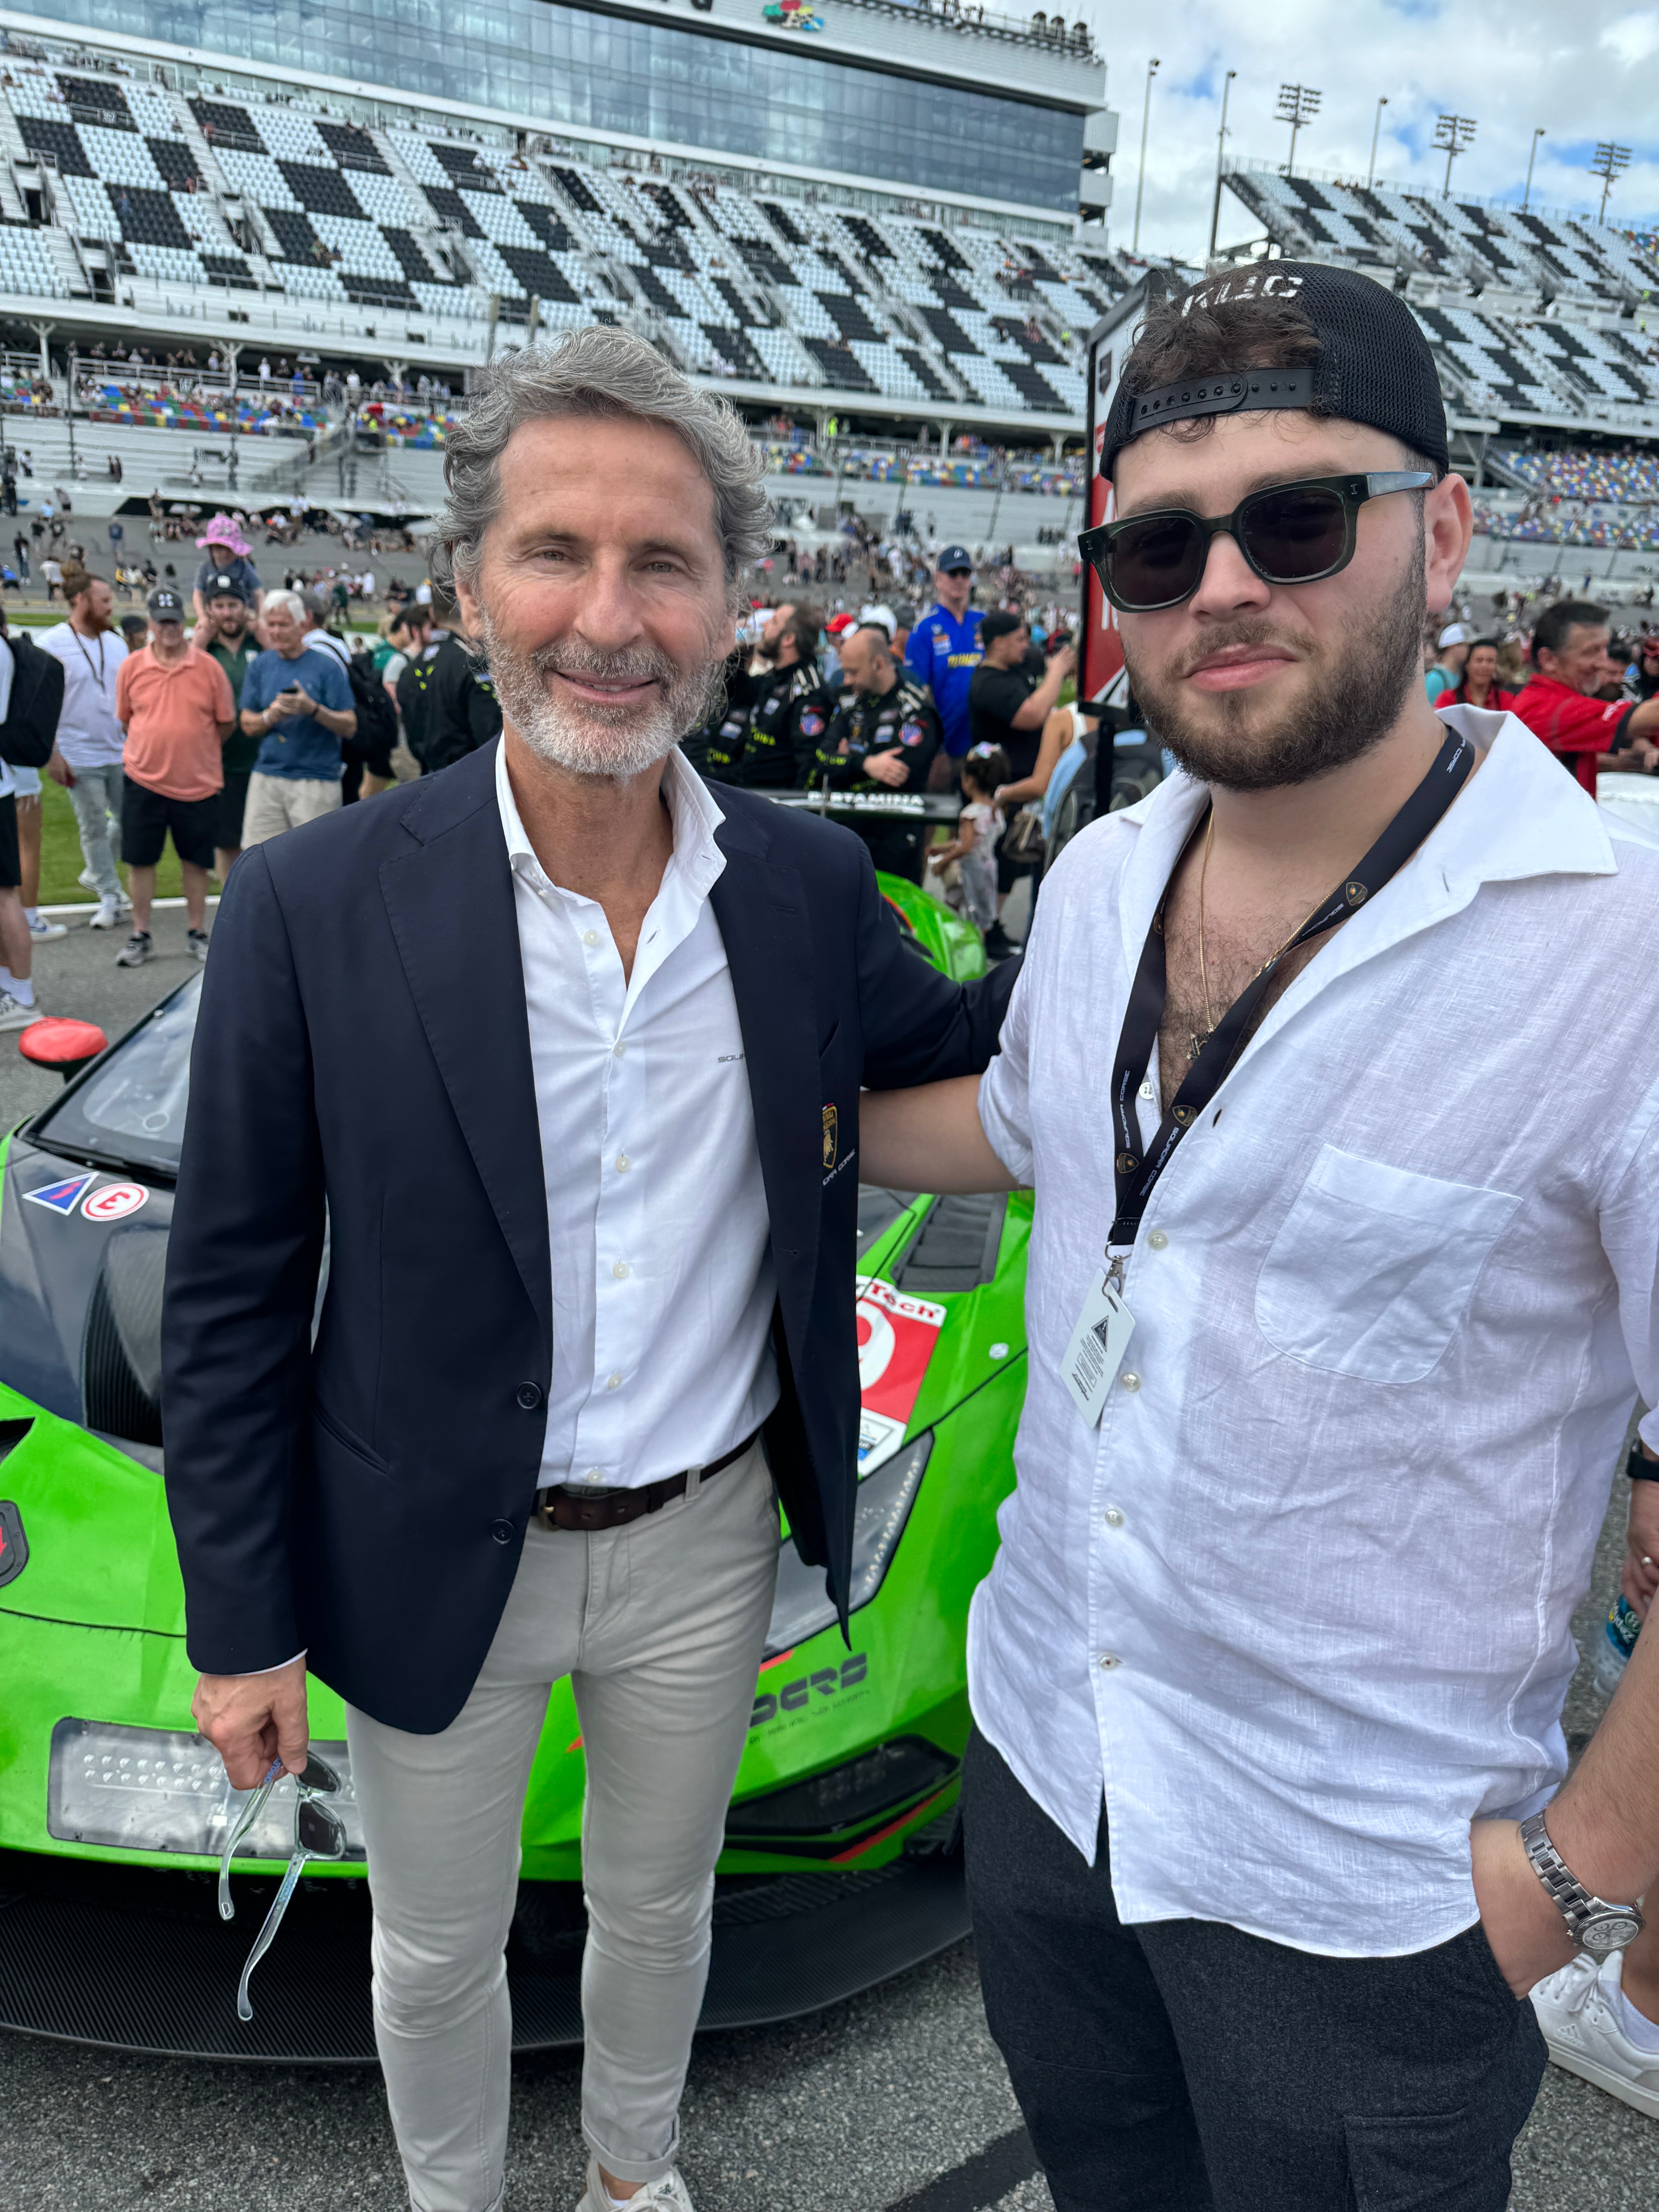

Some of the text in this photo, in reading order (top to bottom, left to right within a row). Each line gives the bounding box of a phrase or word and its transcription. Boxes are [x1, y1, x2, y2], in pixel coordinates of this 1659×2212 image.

[808, 790, 925, 806] PRTAMINA
[1120, 1070, 1130, 1101] CORSE
[1139, 1126, 1180, 1197] SQUADRA CORSE
